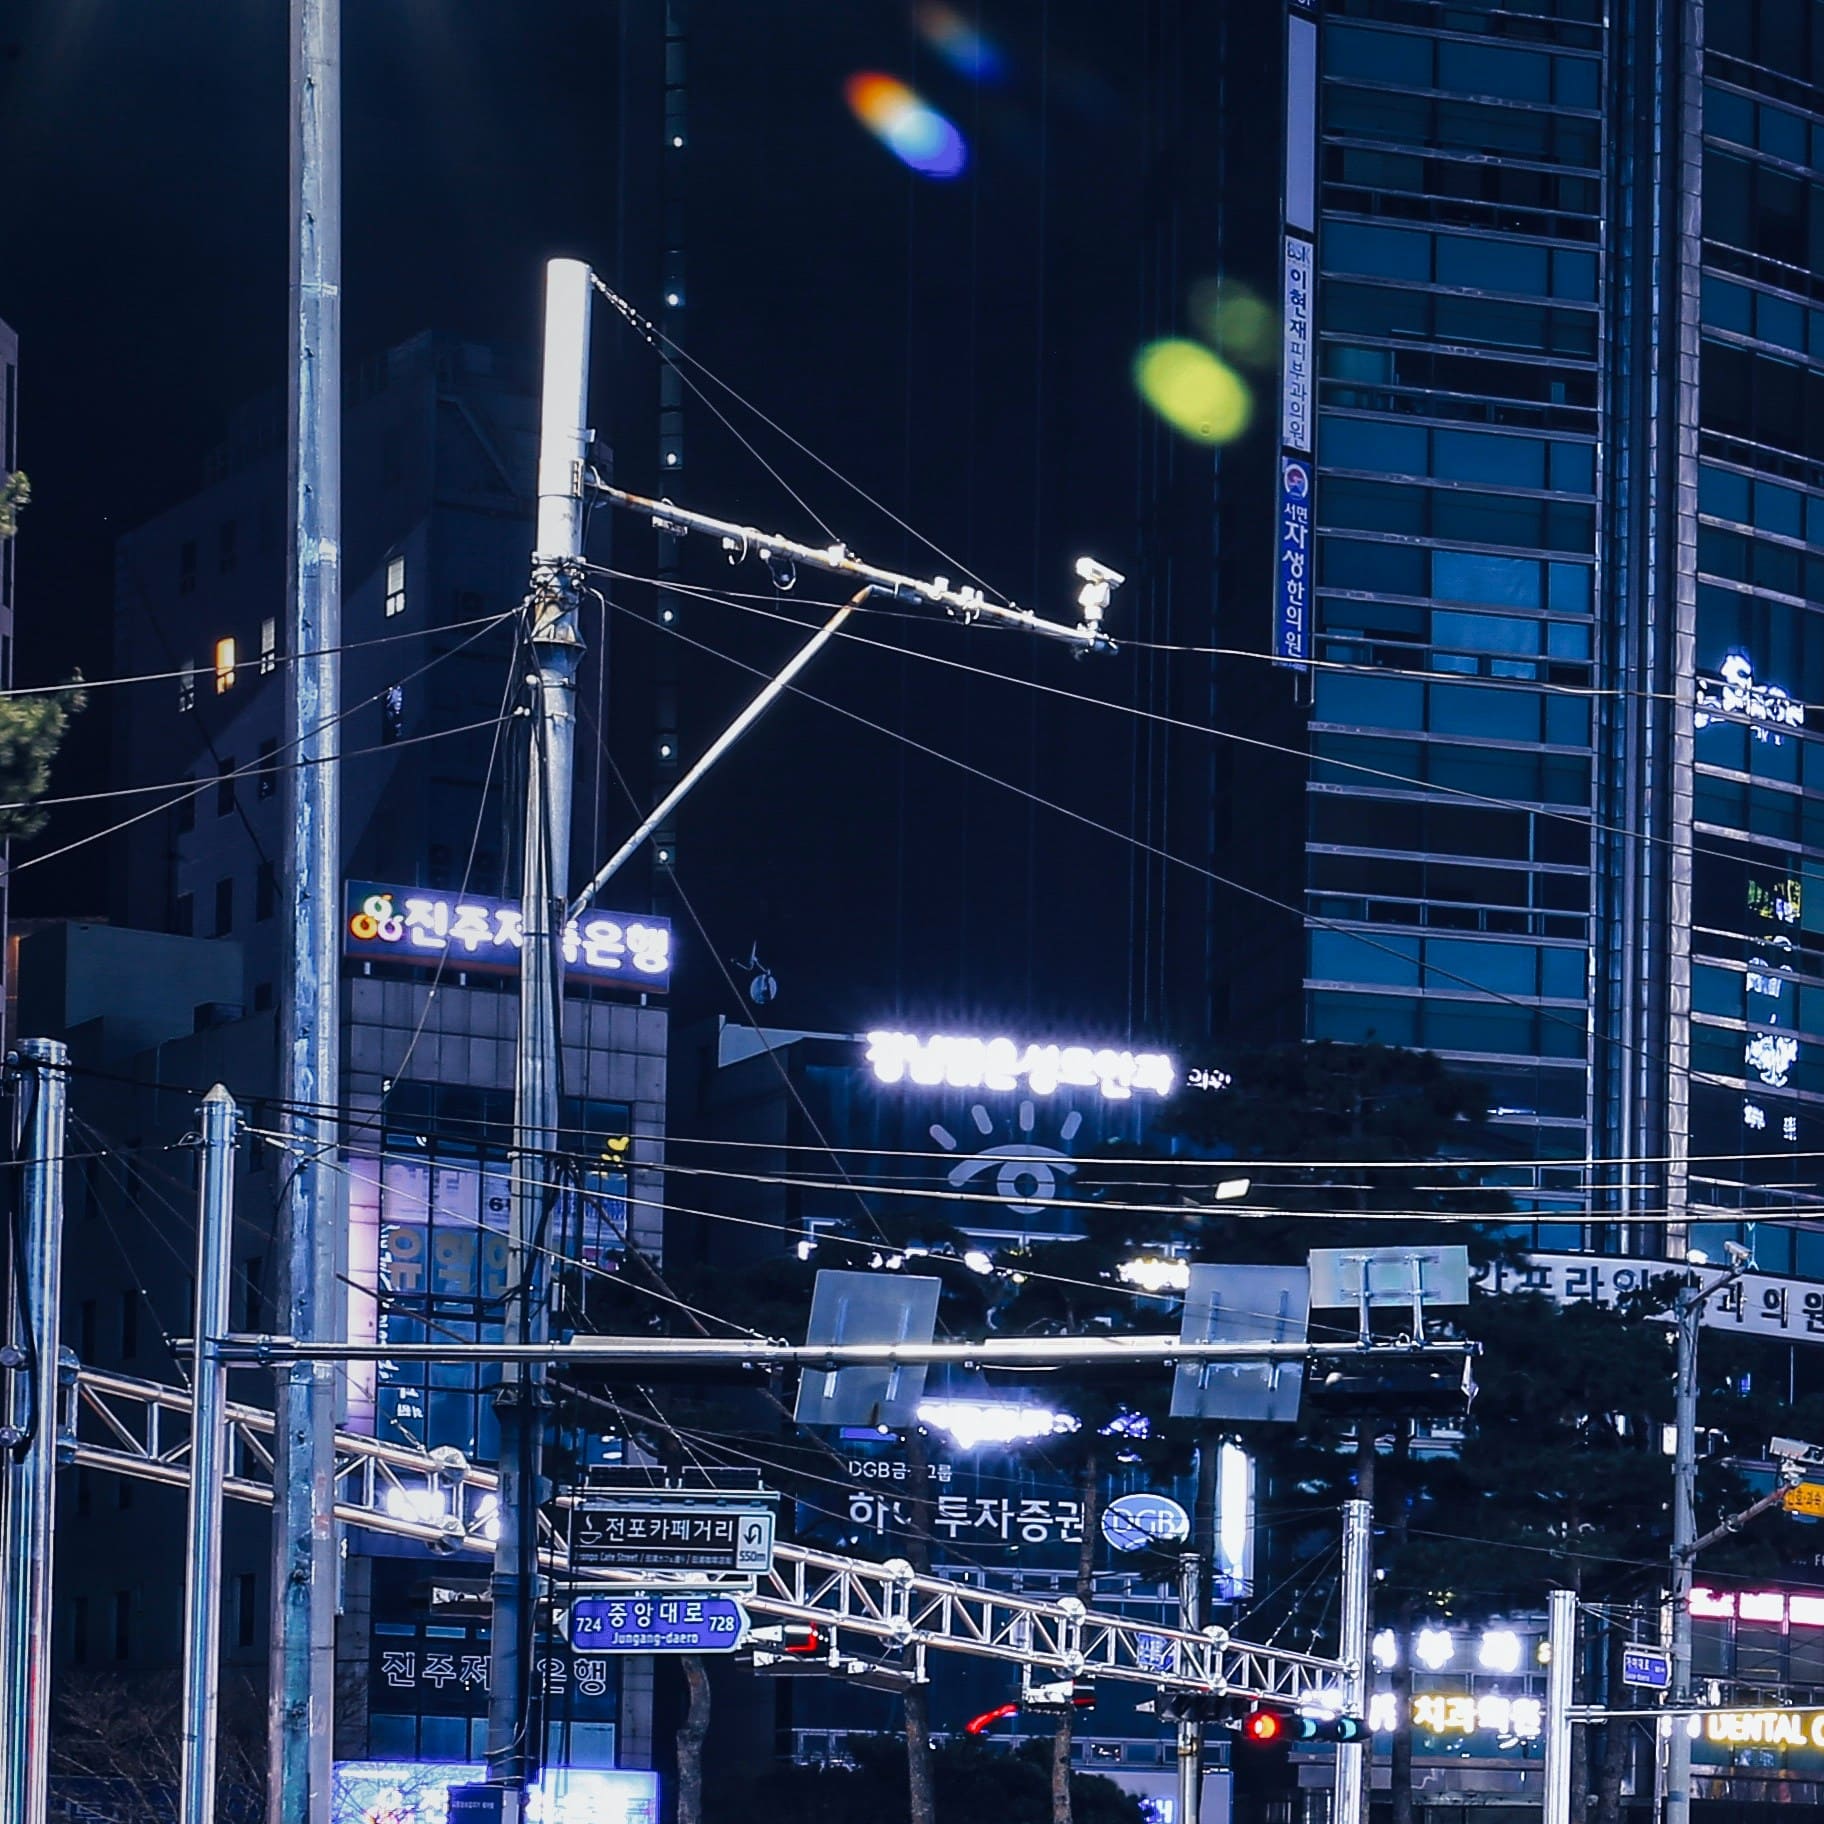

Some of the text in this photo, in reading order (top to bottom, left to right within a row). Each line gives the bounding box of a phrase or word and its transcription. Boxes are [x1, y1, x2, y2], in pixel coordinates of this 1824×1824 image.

[1284, 503, 1308, 524] 서면
[1282, 520, 1309, 658] 자생한의원
[404, 898, 669, 974] 진주저은행
[605, 1517, 734, 1543] 전포카페거리
[1111, 1506, 1178, 1537] DGB
[738, 1550, 766, 1562] 550m
[575, 1602, 736, 1632] 724 중앙대로 728
[611, 1631, 699, 1646] Jungang-daero
[381, 1651, 607, 1696] 진주저은행
[1707, 1715, 1807, 1747] DENTAL
